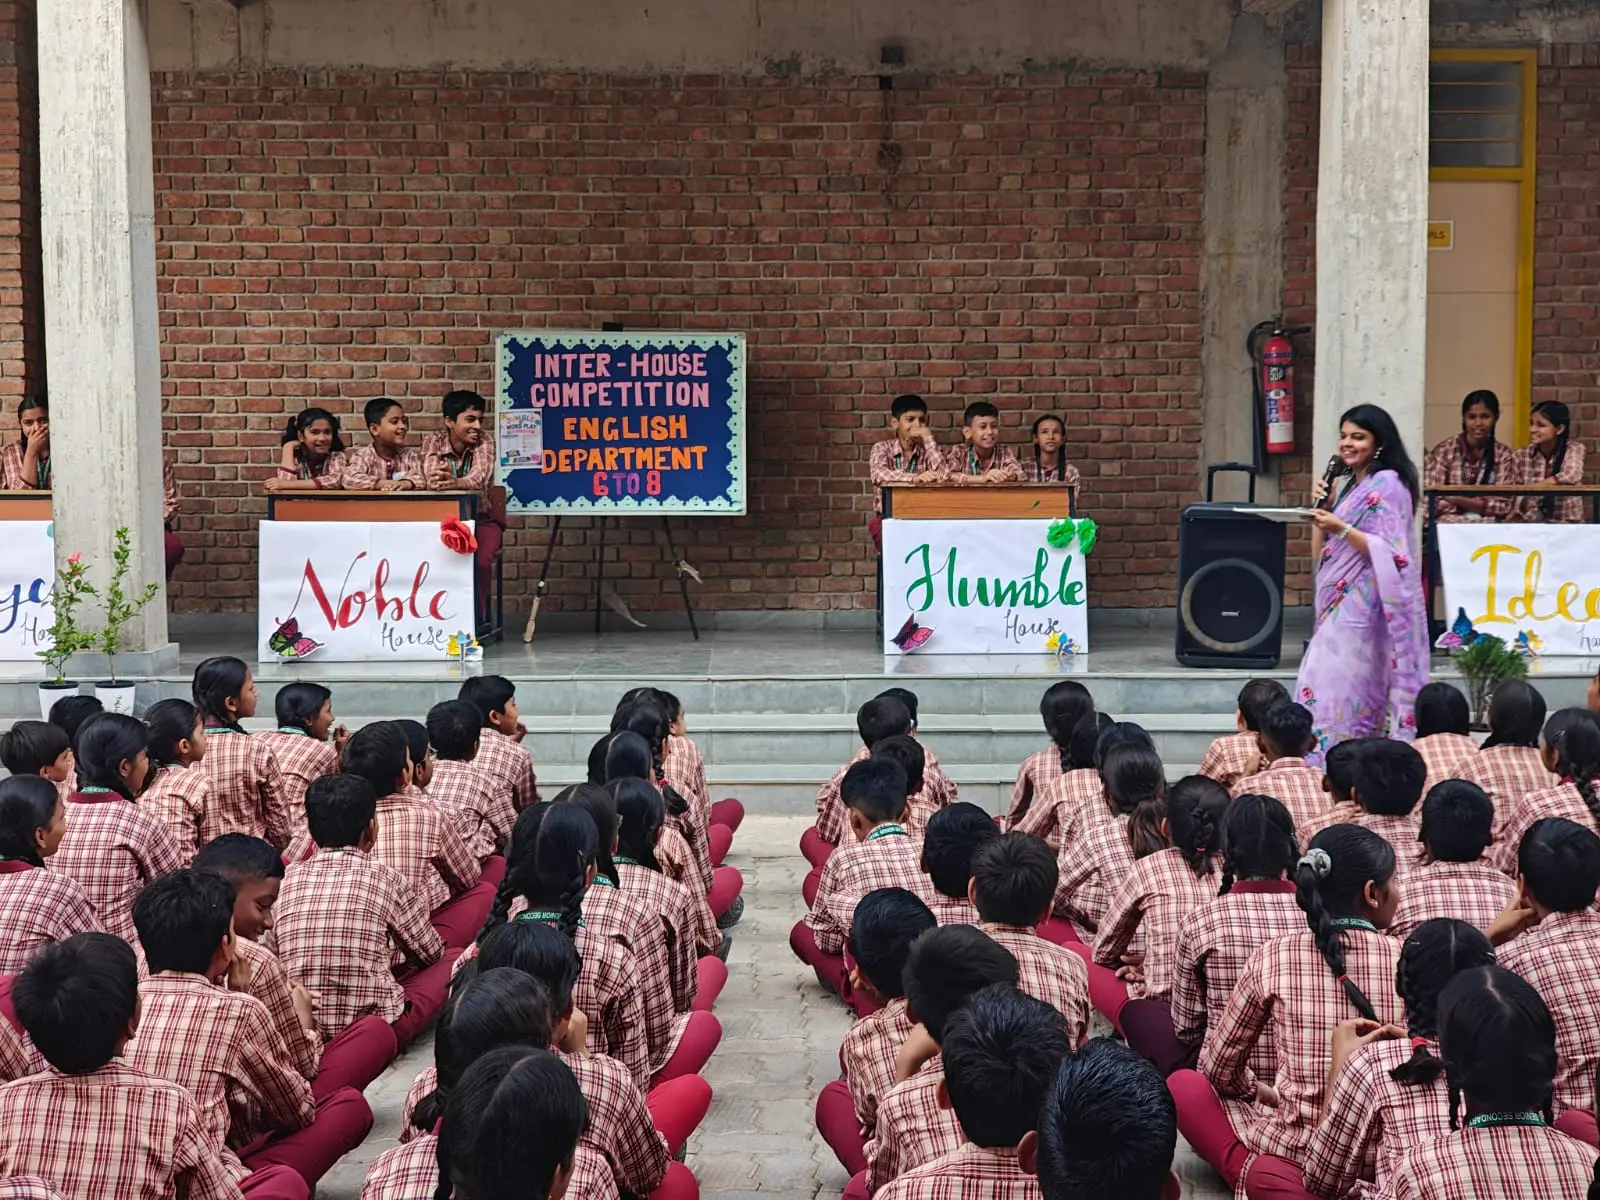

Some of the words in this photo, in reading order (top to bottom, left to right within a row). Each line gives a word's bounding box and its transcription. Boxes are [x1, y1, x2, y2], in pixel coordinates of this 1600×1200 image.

[530, 381, 711, 408] COMPETITION
[563, 414, 688, 441] ENGLISH
[541, 445, 708, 475] DEPARTMENT
[612, 472, 640, 495] TO
[646, 470, 662, 495] 8
[277, 551, 457, 631] Noble
[904, 544, 1085, 612] Humble
[382, 622, 449, 652] House
[1469, 1111, 1514, 1126] SECONDARY
[1515, 1110, 1540, 1122] SENIOR
